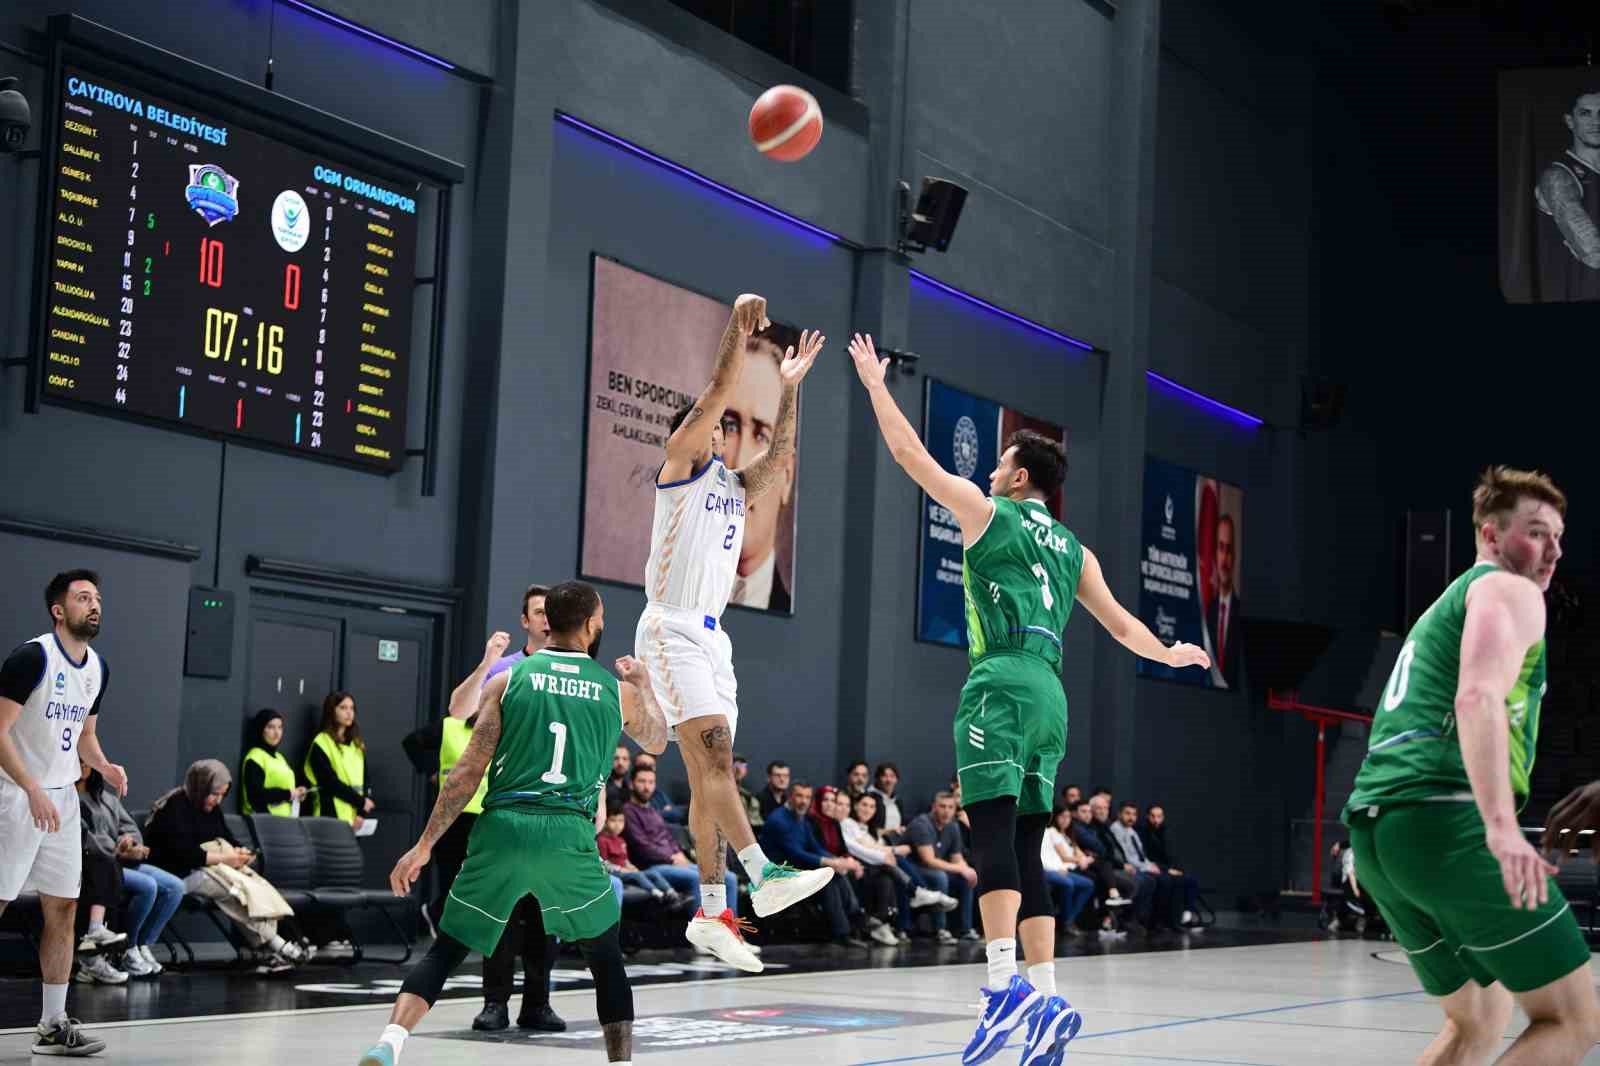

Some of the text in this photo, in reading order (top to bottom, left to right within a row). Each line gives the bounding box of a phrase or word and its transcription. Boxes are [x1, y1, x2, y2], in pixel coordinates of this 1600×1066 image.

[68, 77, 228, 146] ÇAYIROVA BELEDİYESİ
[131, 139, 138, 156] 1
[131, 162, 139, 178] 2
[129, 185, 137, 200] 4
[314, 165, 342, 187] OGM
[344, 176, 417, 214] ORMANSPOR
[128, 207, 136, 222] 7
[146, 212, 155, 230] 5
[127, 229, 135, 246] 9
[200, 236, 224, 289] 10
[323, 247, 331, 262] 2
[144, 256, 153, 274] 2
[122, 274, 132, 291] 15
[143, 279, 152, 296] 3
[284, 264, 301, 310] 0
[121, 296, 134, 314] 20
[320, 308, 327, 323] 7
[119, 319, 132, 337] 23
[204, 308, 284, 374] 07:16
[608, 371, 633, 395] BEN
[313, 390, 325, 407] 22
[722, 524, 736, 550] 2
[1383, 639, 1416, 713] 0
[529, 672, 602, 701] WRIGHT
[61, 727, 72, 751] 9
[540, 721, 568, 785] 1
